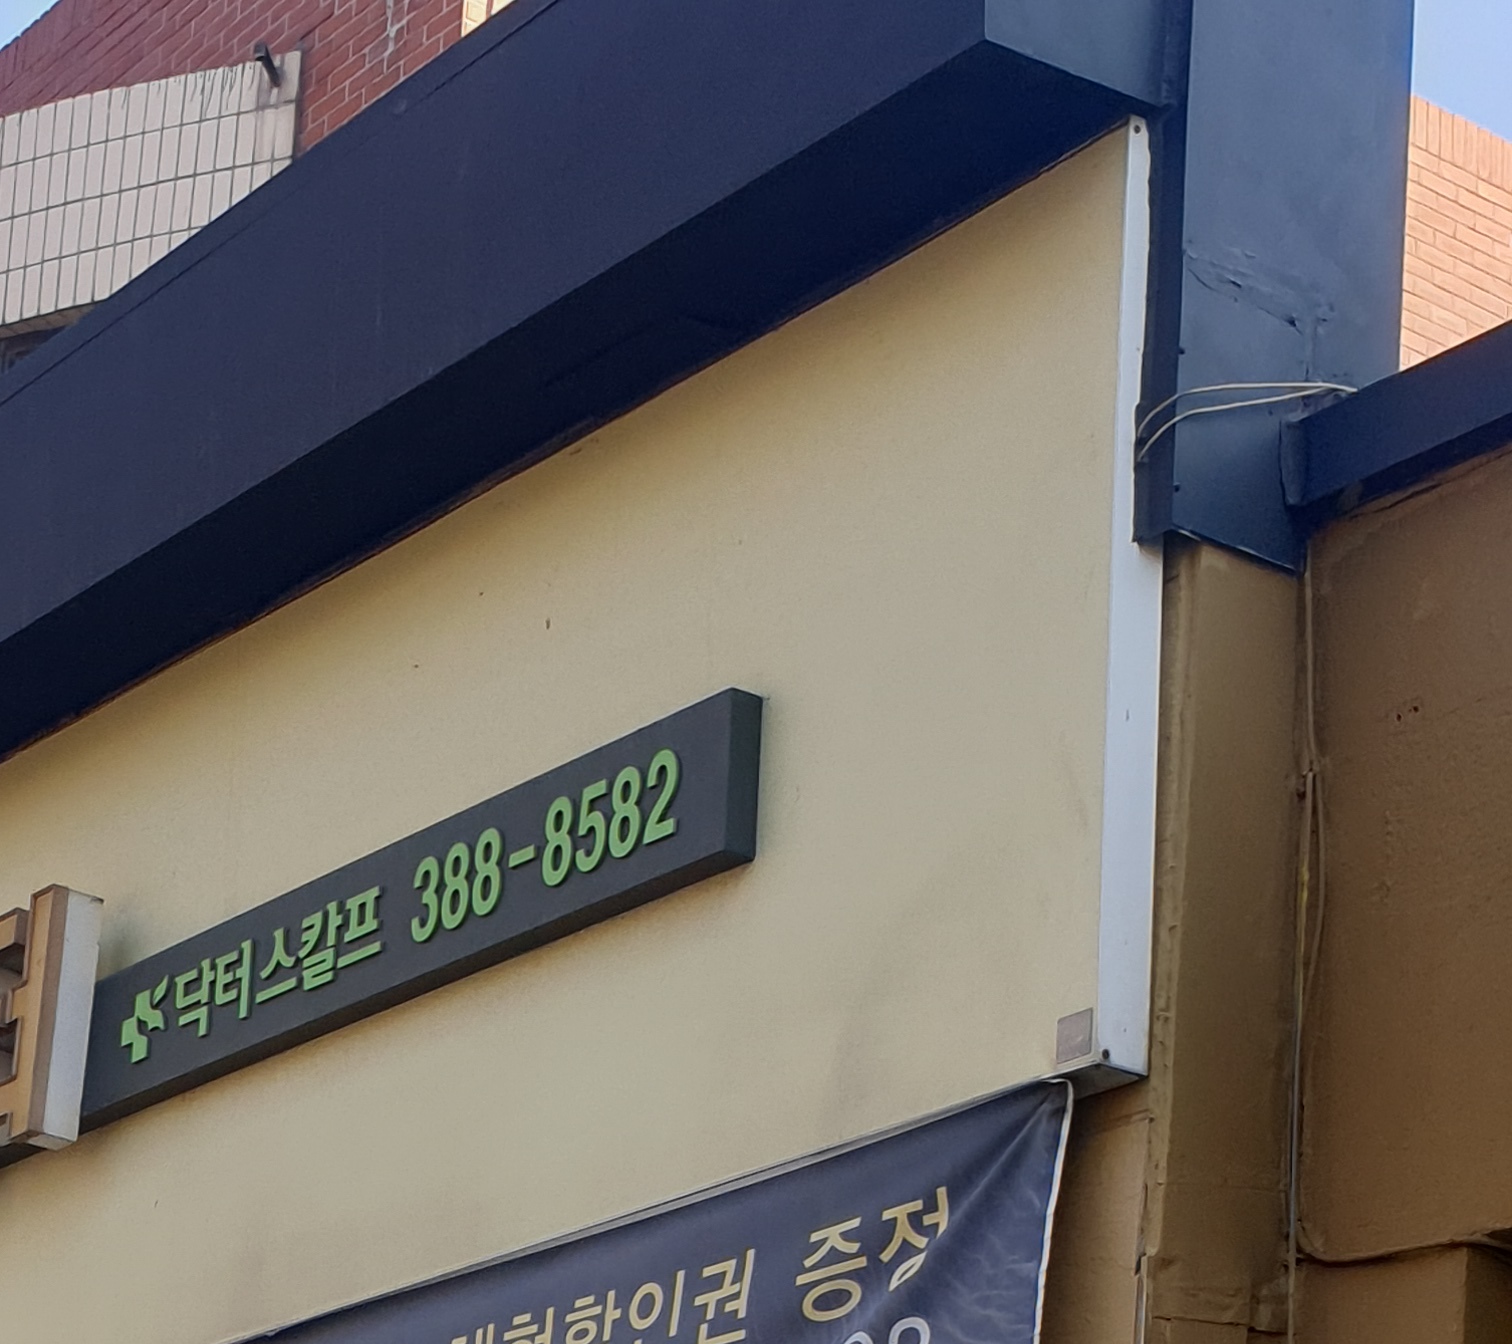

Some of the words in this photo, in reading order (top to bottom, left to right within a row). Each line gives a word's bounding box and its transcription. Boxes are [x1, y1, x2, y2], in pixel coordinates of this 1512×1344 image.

[174, 885, 382, 1038] 닥터스칼프
[410, 748, 680, 944] 388-8582
[794, 1186, 949, 1323] 증정
